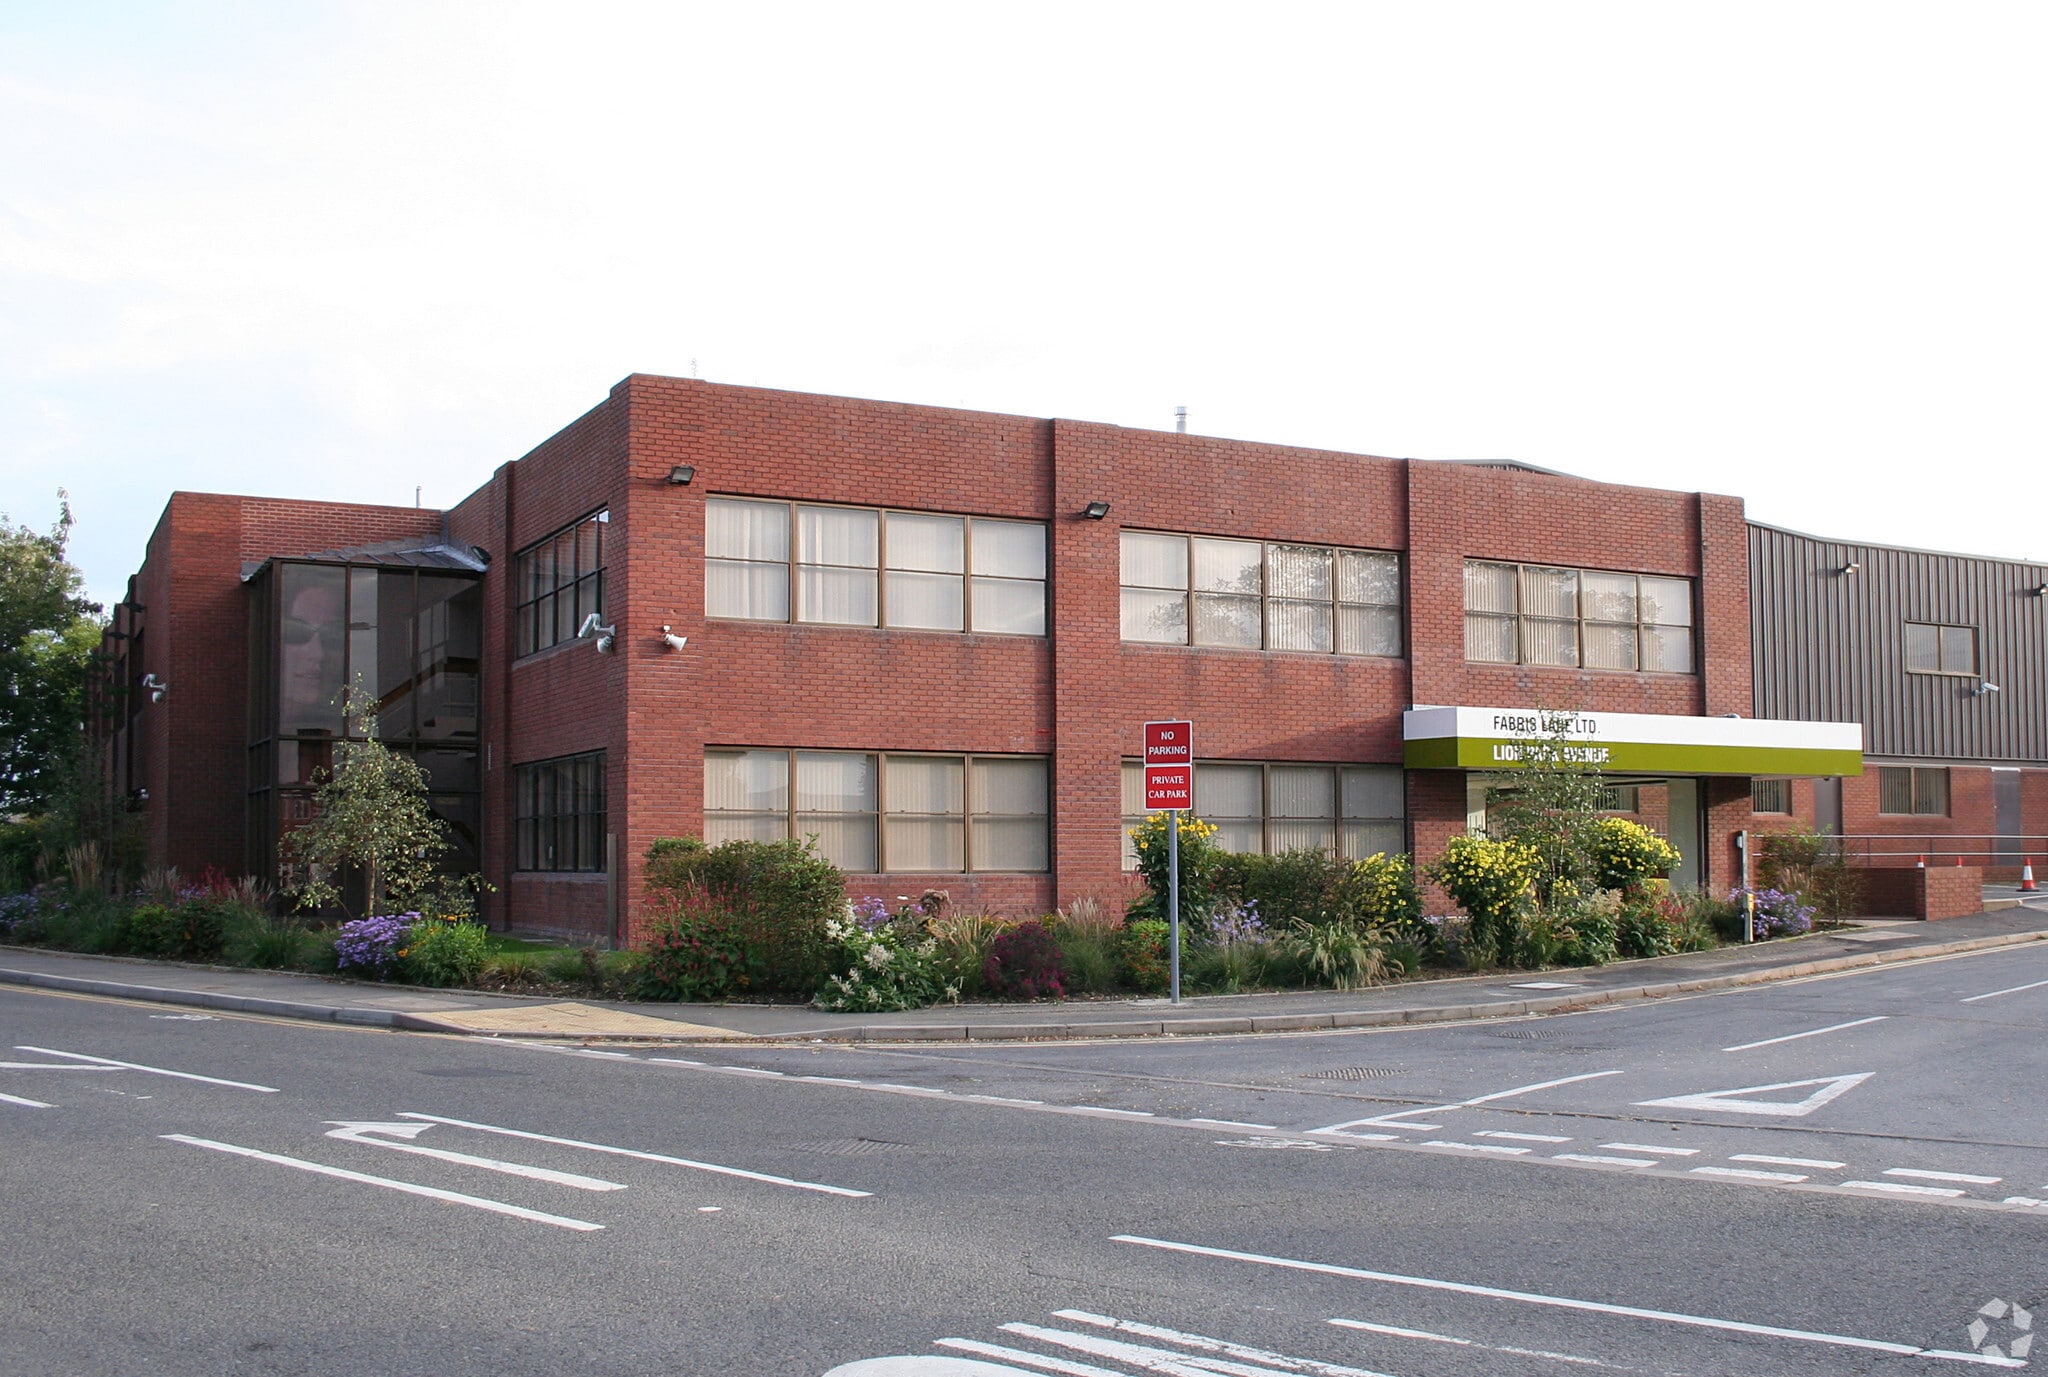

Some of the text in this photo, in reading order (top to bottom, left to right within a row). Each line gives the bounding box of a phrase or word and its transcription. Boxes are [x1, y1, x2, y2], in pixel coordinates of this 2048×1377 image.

[1576, 719, 1600, 734] LTD.
[1161, 731, 1174, 740] NO
[1148, 746, 1187, 755] PARKING
[1152, 775, 1184, 784] PRIVATE
[1148, 790, 1187, 798] CAR PARK
